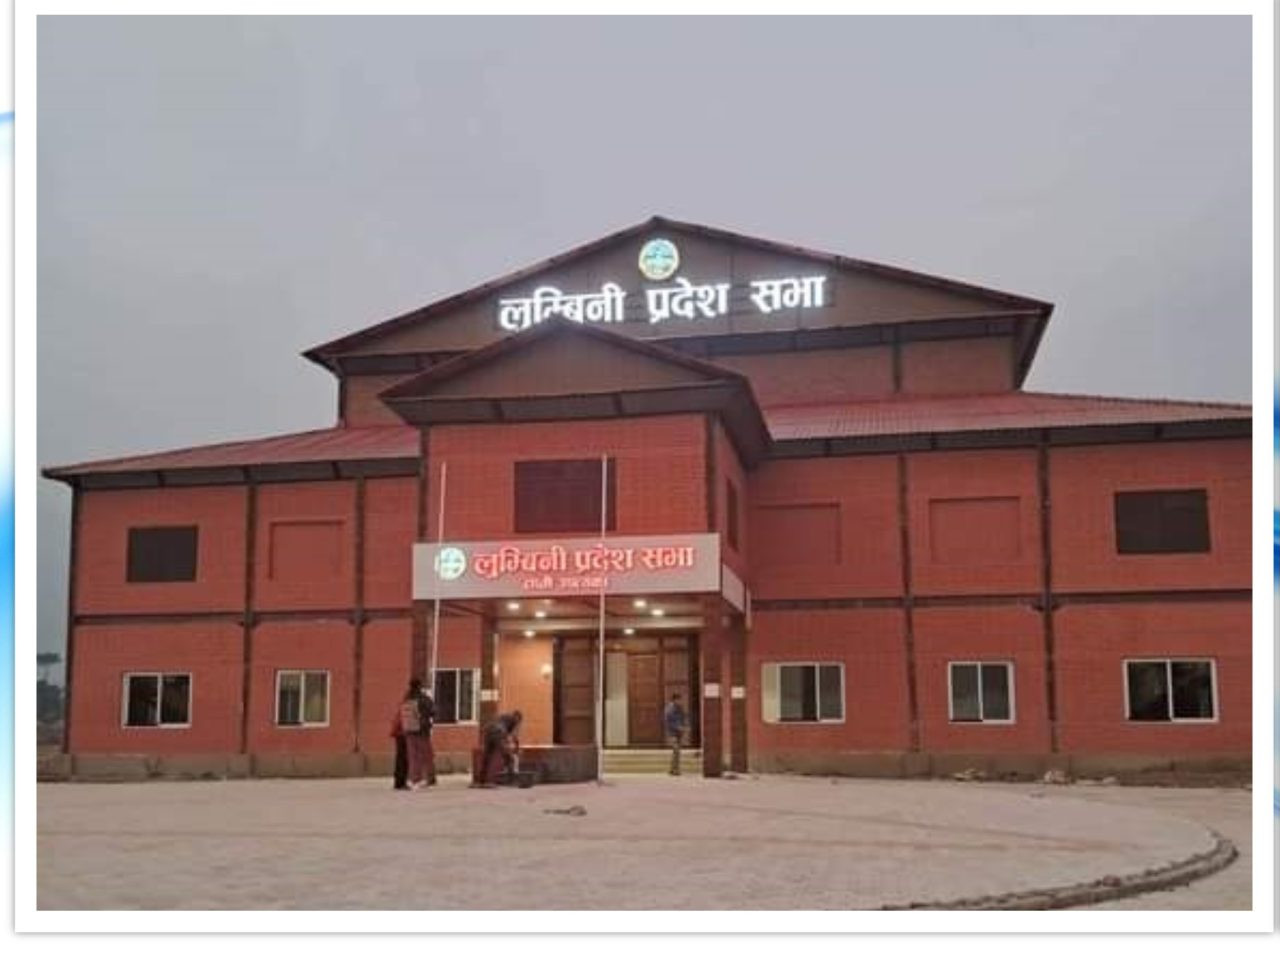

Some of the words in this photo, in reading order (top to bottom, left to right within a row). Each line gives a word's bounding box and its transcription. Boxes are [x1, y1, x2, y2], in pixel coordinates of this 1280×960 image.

[646, 277, 730, 323] प्रदेश
[750, 275, 827, 314] सभा
[574, 543, 633, 574] प्रदेश
[641, 546, 695, 569] सभा
